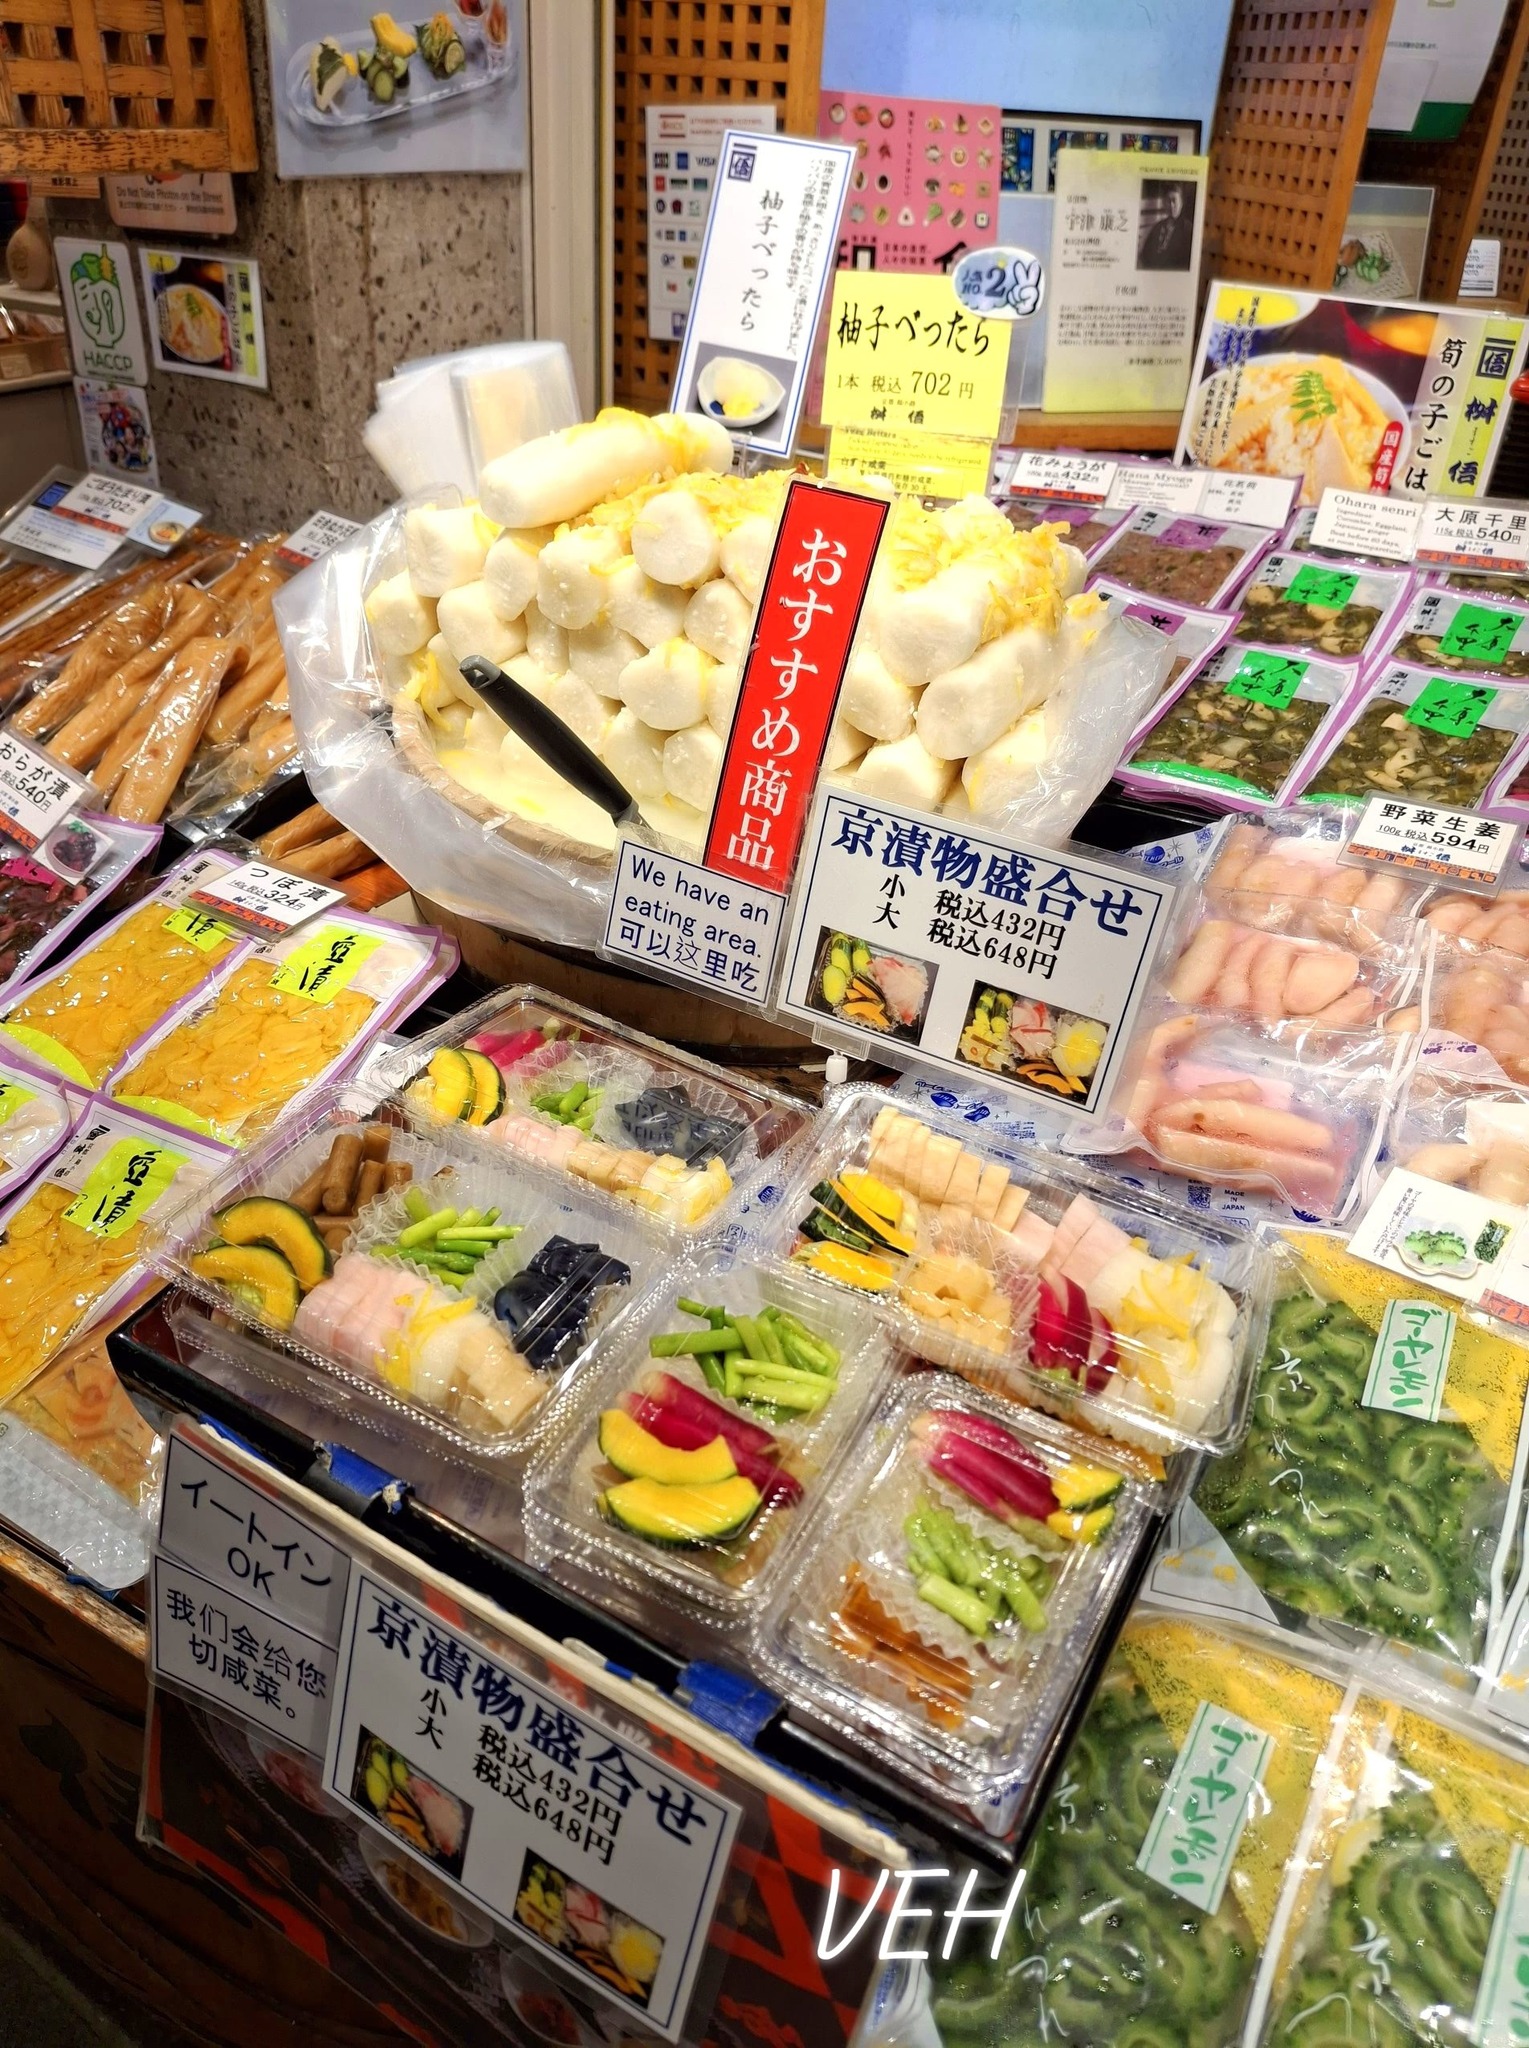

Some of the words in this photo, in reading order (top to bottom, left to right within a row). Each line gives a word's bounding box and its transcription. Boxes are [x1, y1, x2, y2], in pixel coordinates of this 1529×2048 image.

[738, 189, 785, 332] 柚子べったら
[984, 265, 1006, 298] 2
[82, 349, 133, 371] HACCP
[836, 301, 990, 357] 柚子べったら
[836, 373, 860, 391] 1本
[871, 375, 902, 394] 税込
[910, 370, 952, 397] 702
[958, 381, 975, 400] 円
[1404, 338, 1467, 501] 筍の子ごは
[1029, 456, 1107, 472] 花みょうが
[1334, 493, 1377, 511] Ohara
[1381, 504, 1417, 518] senri
[1434, 507, 1528, 532] 大原千里
[725, 528, 848, 872] おすすめ商品
[0, 741, 72, 802] おらが漬
[1379, 802, 1502, 841] 野菜生姜
[1404, 830, 1491, 855] 税込594円
[249, 866, 331, 903] つぼ漬
[632, 854, 667, 888] We
[674, 870, 731, 912] have
[739, 901, 770, 926] an
[830, 808, 1143, 937] 京漬物盛合せ
[625, 894, 698, 938] eating
[704, 923, 762, 959] area.
[872, 901, 902, 931] 大
[925, 915, 1059, 981] 税込648円
[878, 874, 906, 900] 小
[933, 887, 1068, 953] 税込432円
[619, 917, 761, 993] 可以这里吃
[1221, 1203, 1246, 1212] JAPAN
[1223, 1188, 1246, 1198] MADE
[180, 1480, 332, 1587] イートイン
[226, 1546, 277, 1598] OK
[165, 1587, 328, 1699] 我们会给您
[188, 1632, 297, 1720] 切咸菜。
[367, 1594, 708, 1847] 京漬物盛合せ
[415, 1716, 443, 1750] 大
[471, 1752, 617, 1866] 税込648円
[419, 1687, 448, 1718] 小
[477, 1723, 623, 1839] 税込432円
